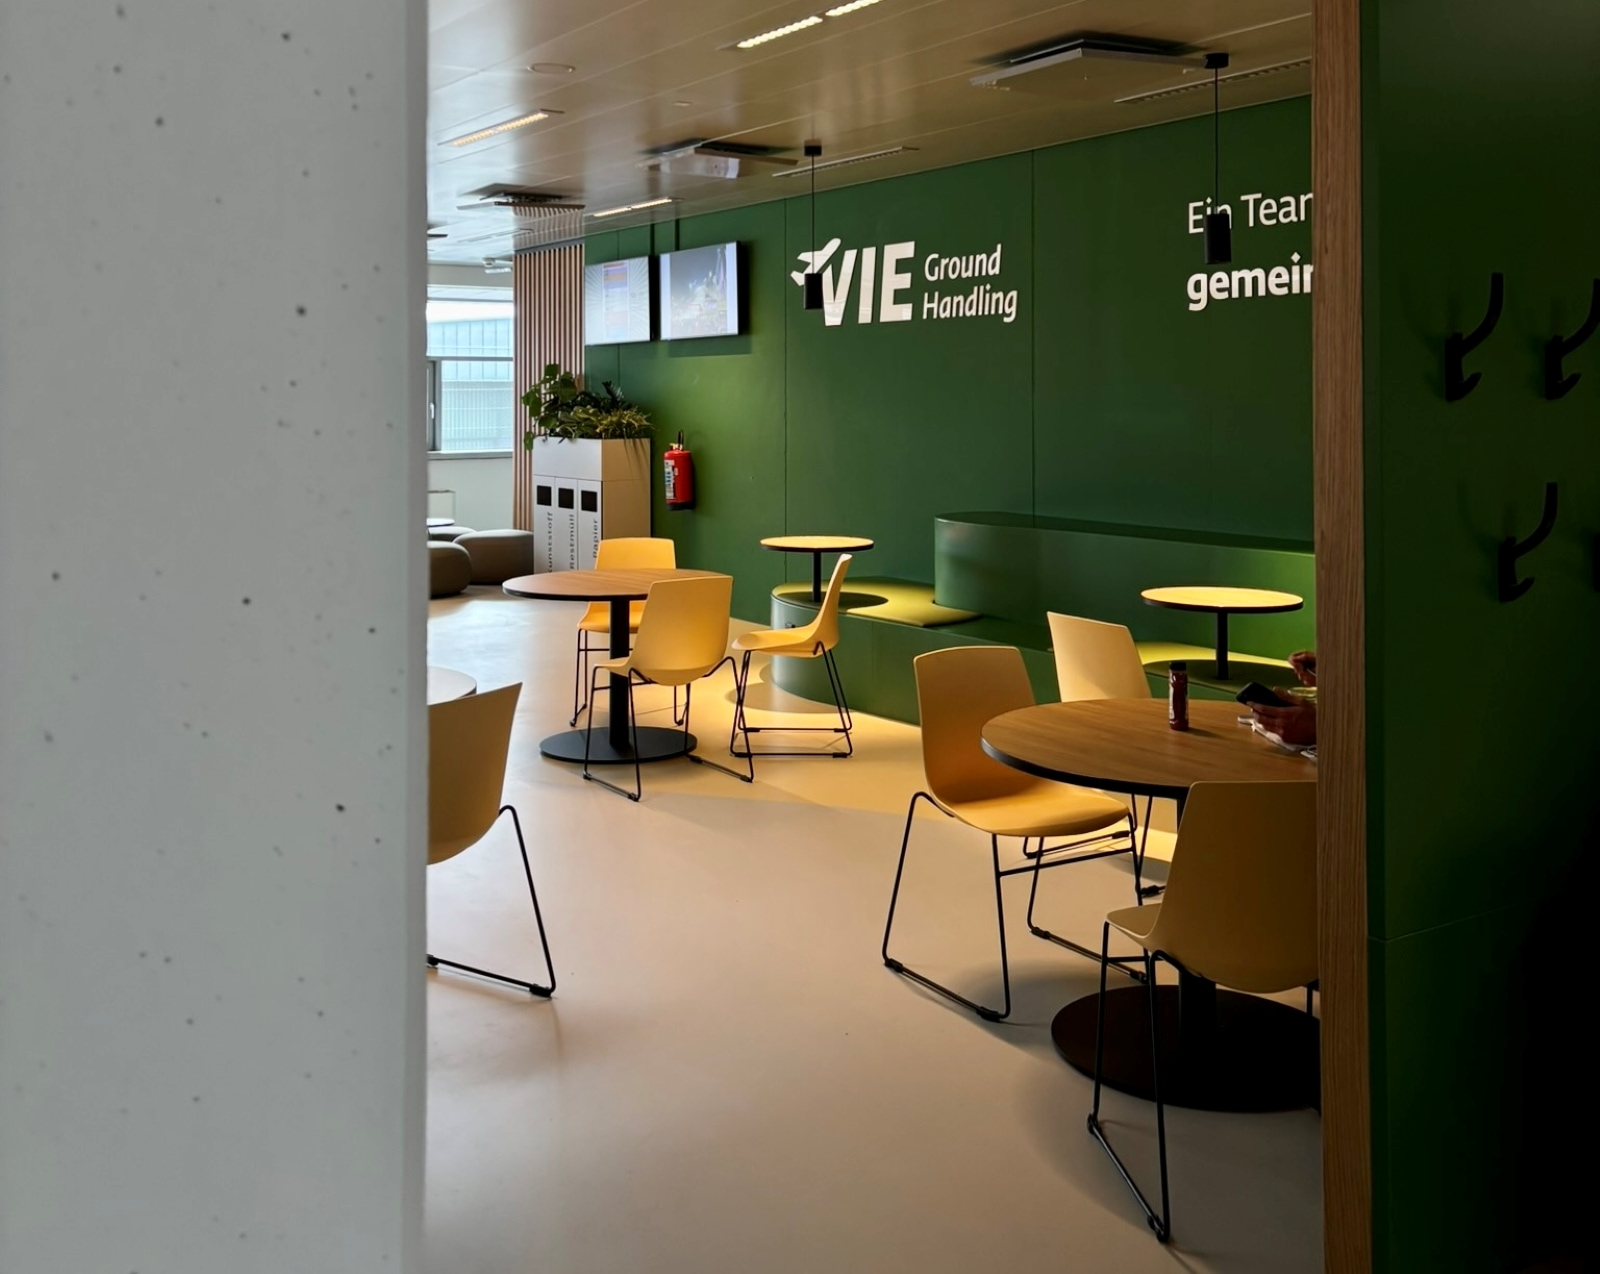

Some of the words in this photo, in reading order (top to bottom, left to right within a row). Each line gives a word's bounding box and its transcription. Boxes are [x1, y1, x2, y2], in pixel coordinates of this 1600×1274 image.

[924, 243, 1002, 282] Ground
[822, 241, 915, 327] VIE
[922, 283, 1018, 323] Handling
